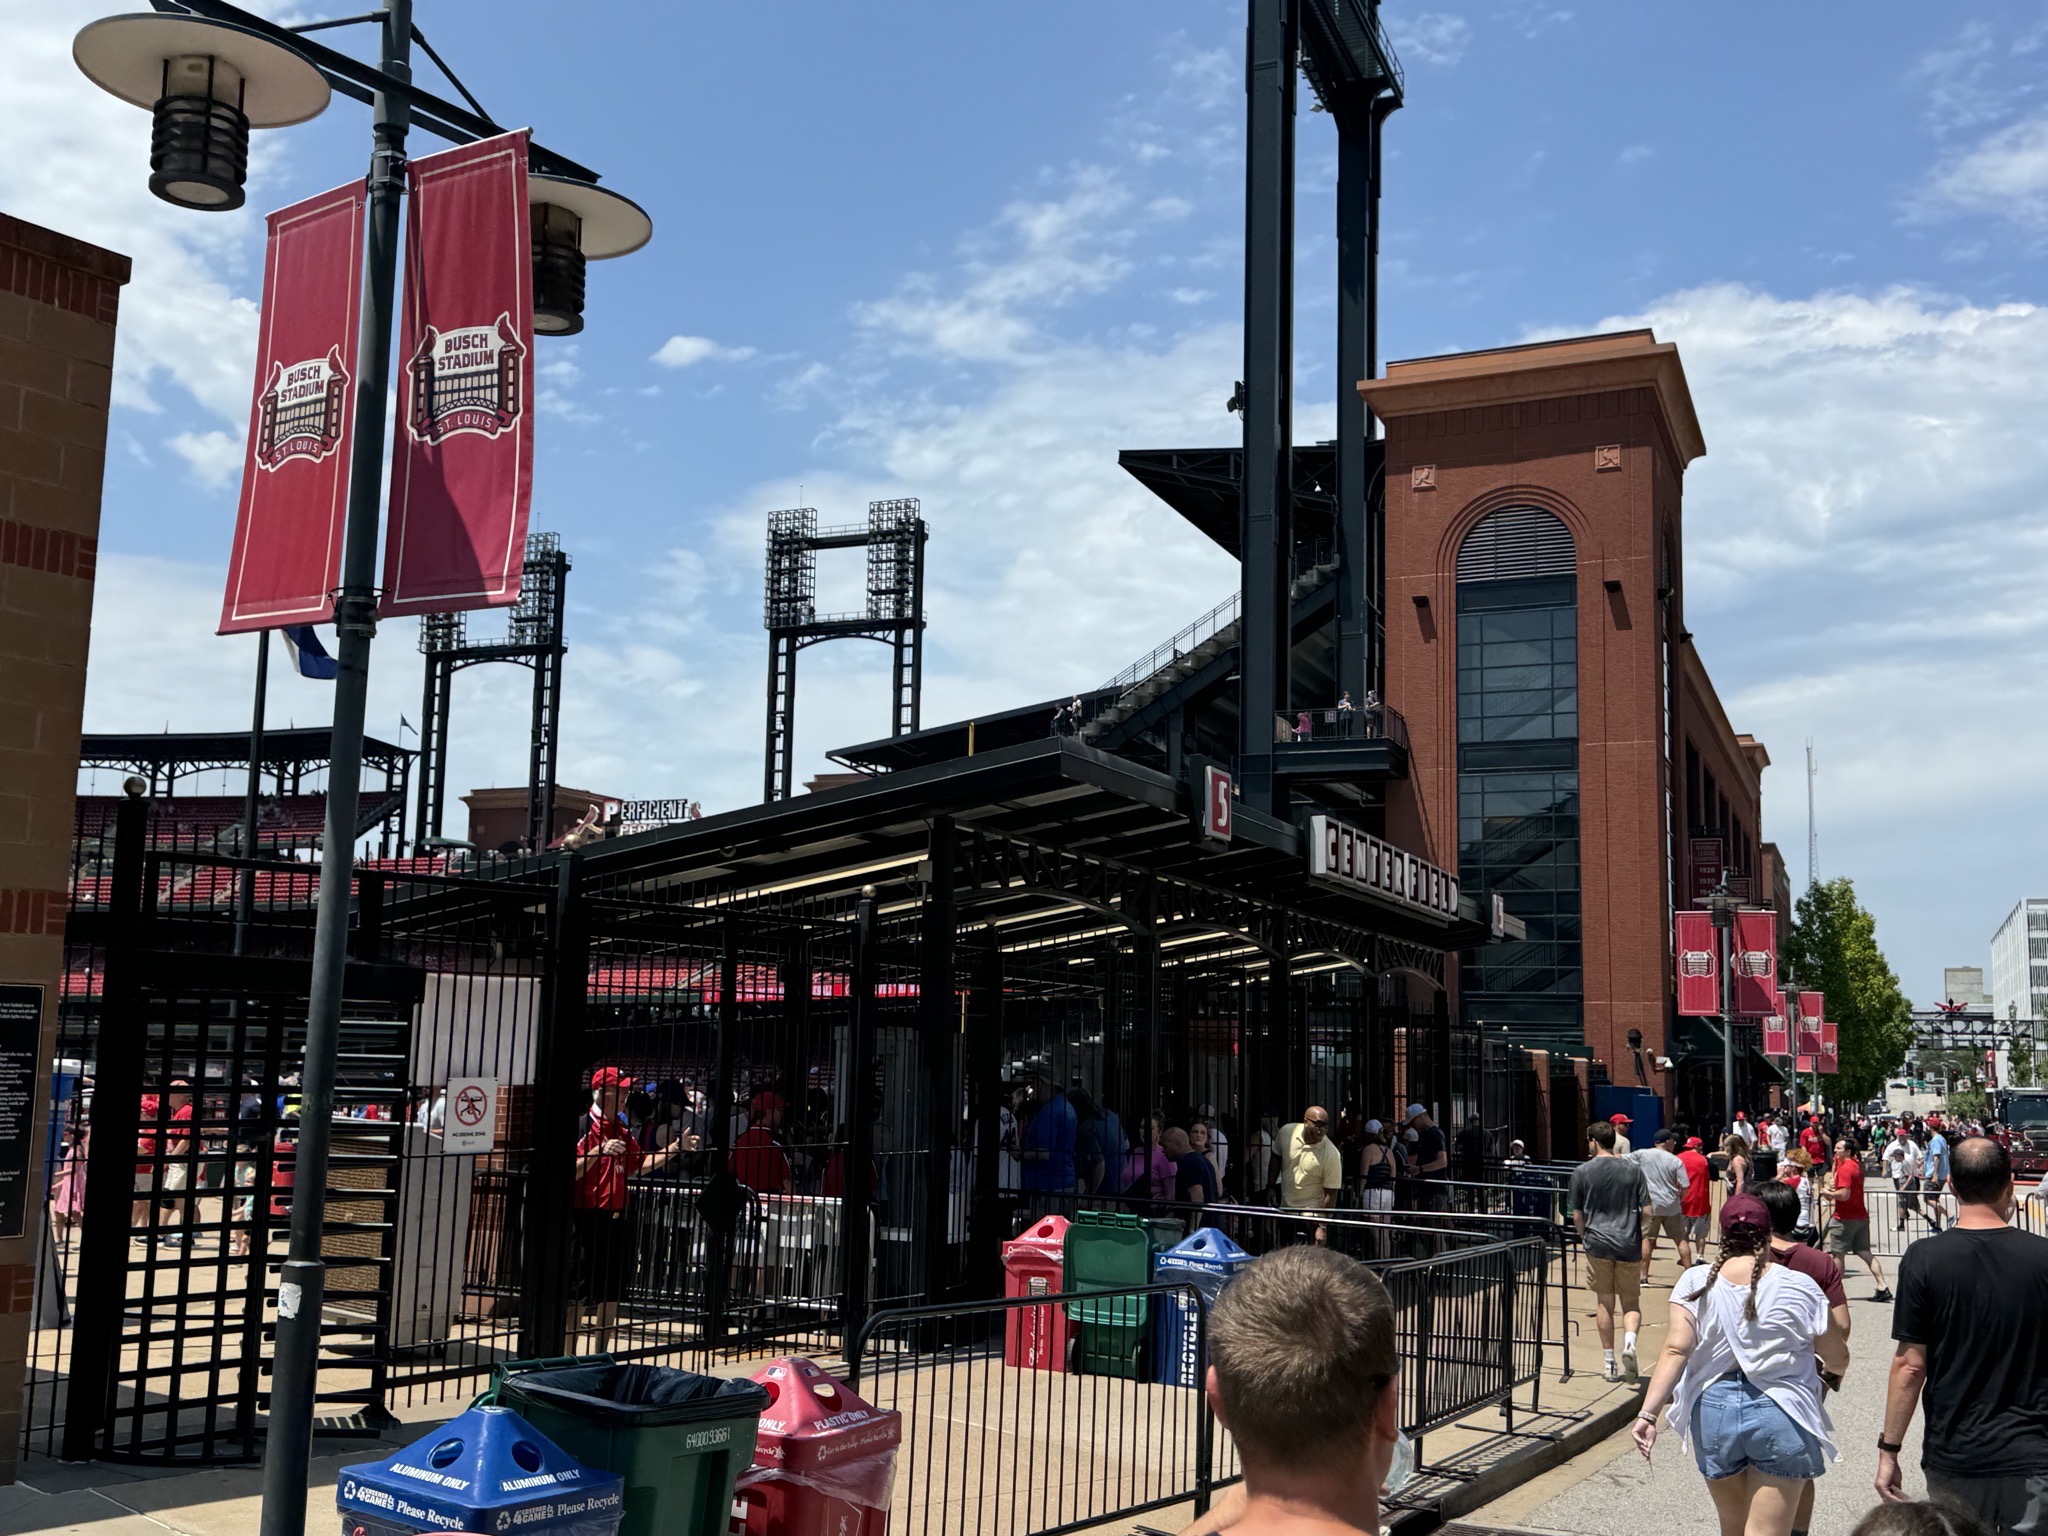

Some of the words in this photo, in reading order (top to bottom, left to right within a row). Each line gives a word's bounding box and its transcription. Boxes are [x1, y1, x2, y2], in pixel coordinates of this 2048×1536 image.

[444, 333, 488, 354] BUSCH
[438, 349, 494, 371] STADIUM
[287, 366, 321, 387] BUSCH
[280, 380, 325, 403] STADIUM
[436, 418, 453, 433] ST.
[457, 413, 492, 428] LOUIS
[290, 440, 319, 453] LOUIS
[603, 799, 687, 823] PERFICIENT
[1217, 781, 1228, 827] 5
[758, 1418, 787, 1431] ONLY
[813, 1411, 849, 1430] PLASTIC
[848, 1410, 870, 1422] ONLY
[389, 1463, 444, 1484] ALUMINUM
[442, 1476, 470, 1491] ONLY
[502, 1474, 557, 1492] ALUMINUM
[556, 1469, 581, 1482] ONLY
[364, 1493, 388, 1508] GAME
[557, 1503, 585, 1517] Please
[587, 1492, 619, 1510] Recycle
[396, 1499, 426, 1520] Please
[426, 1509, 465, 1532] Recycle
[522, 1511, 547, 1523] GAME
